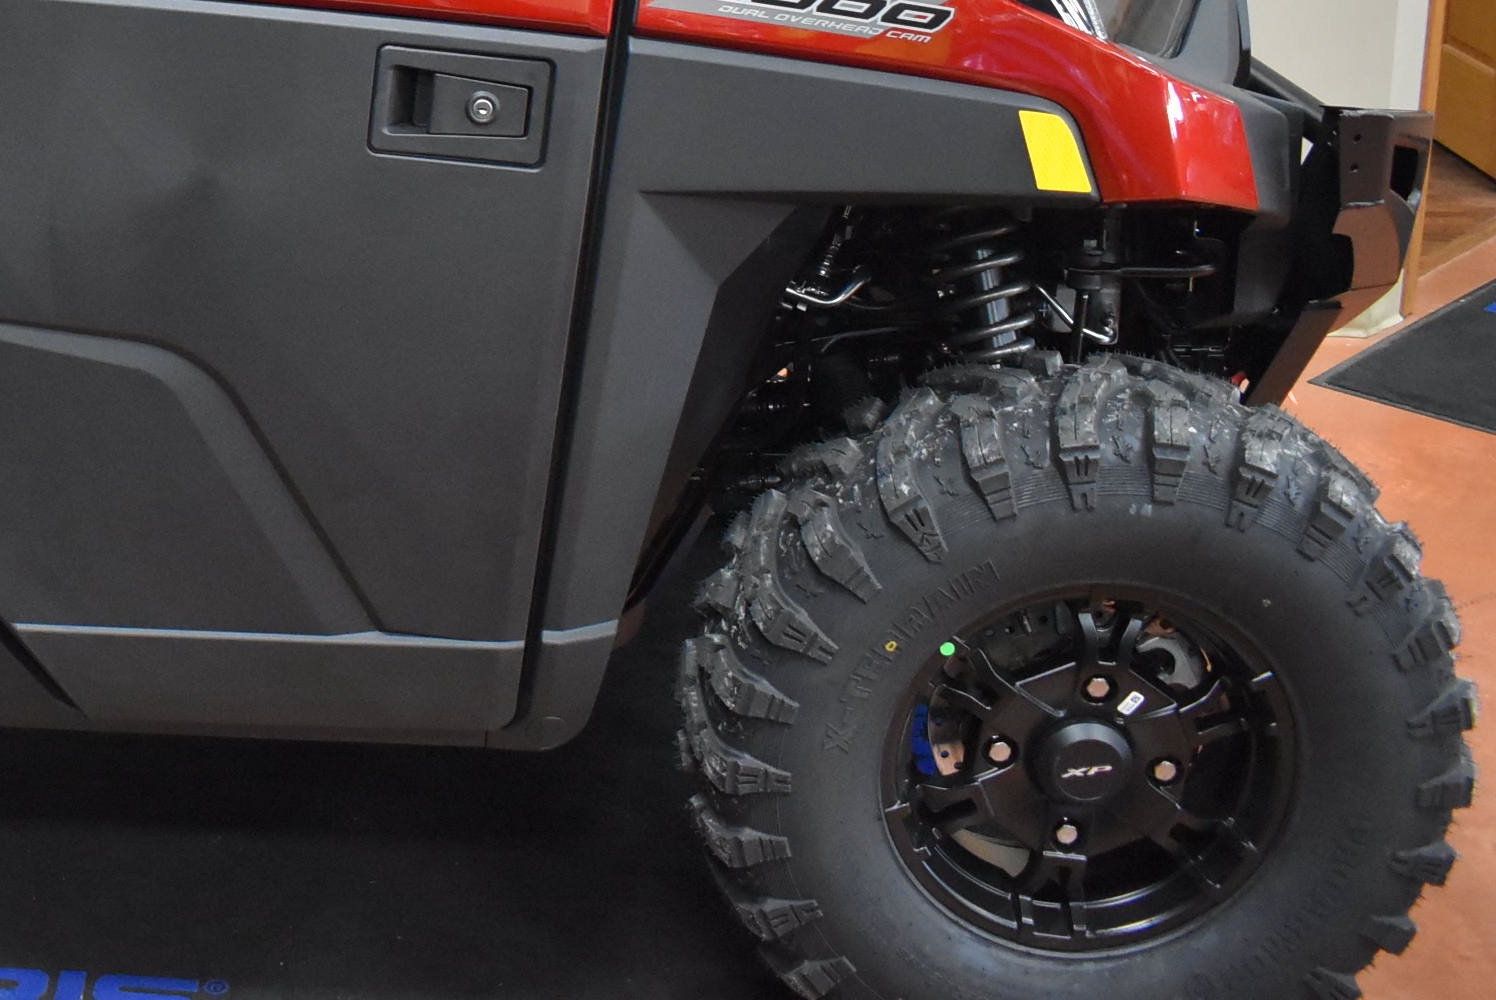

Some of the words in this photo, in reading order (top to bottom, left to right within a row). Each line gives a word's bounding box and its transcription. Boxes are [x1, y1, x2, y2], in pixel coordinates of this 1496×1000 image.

[718, 4, 774, 21] DUAL
[774, 12, 884, 37] OVERHEAD
[885, 29, 934, 45] CAM
[1059, 765, 1114, 780] XP
